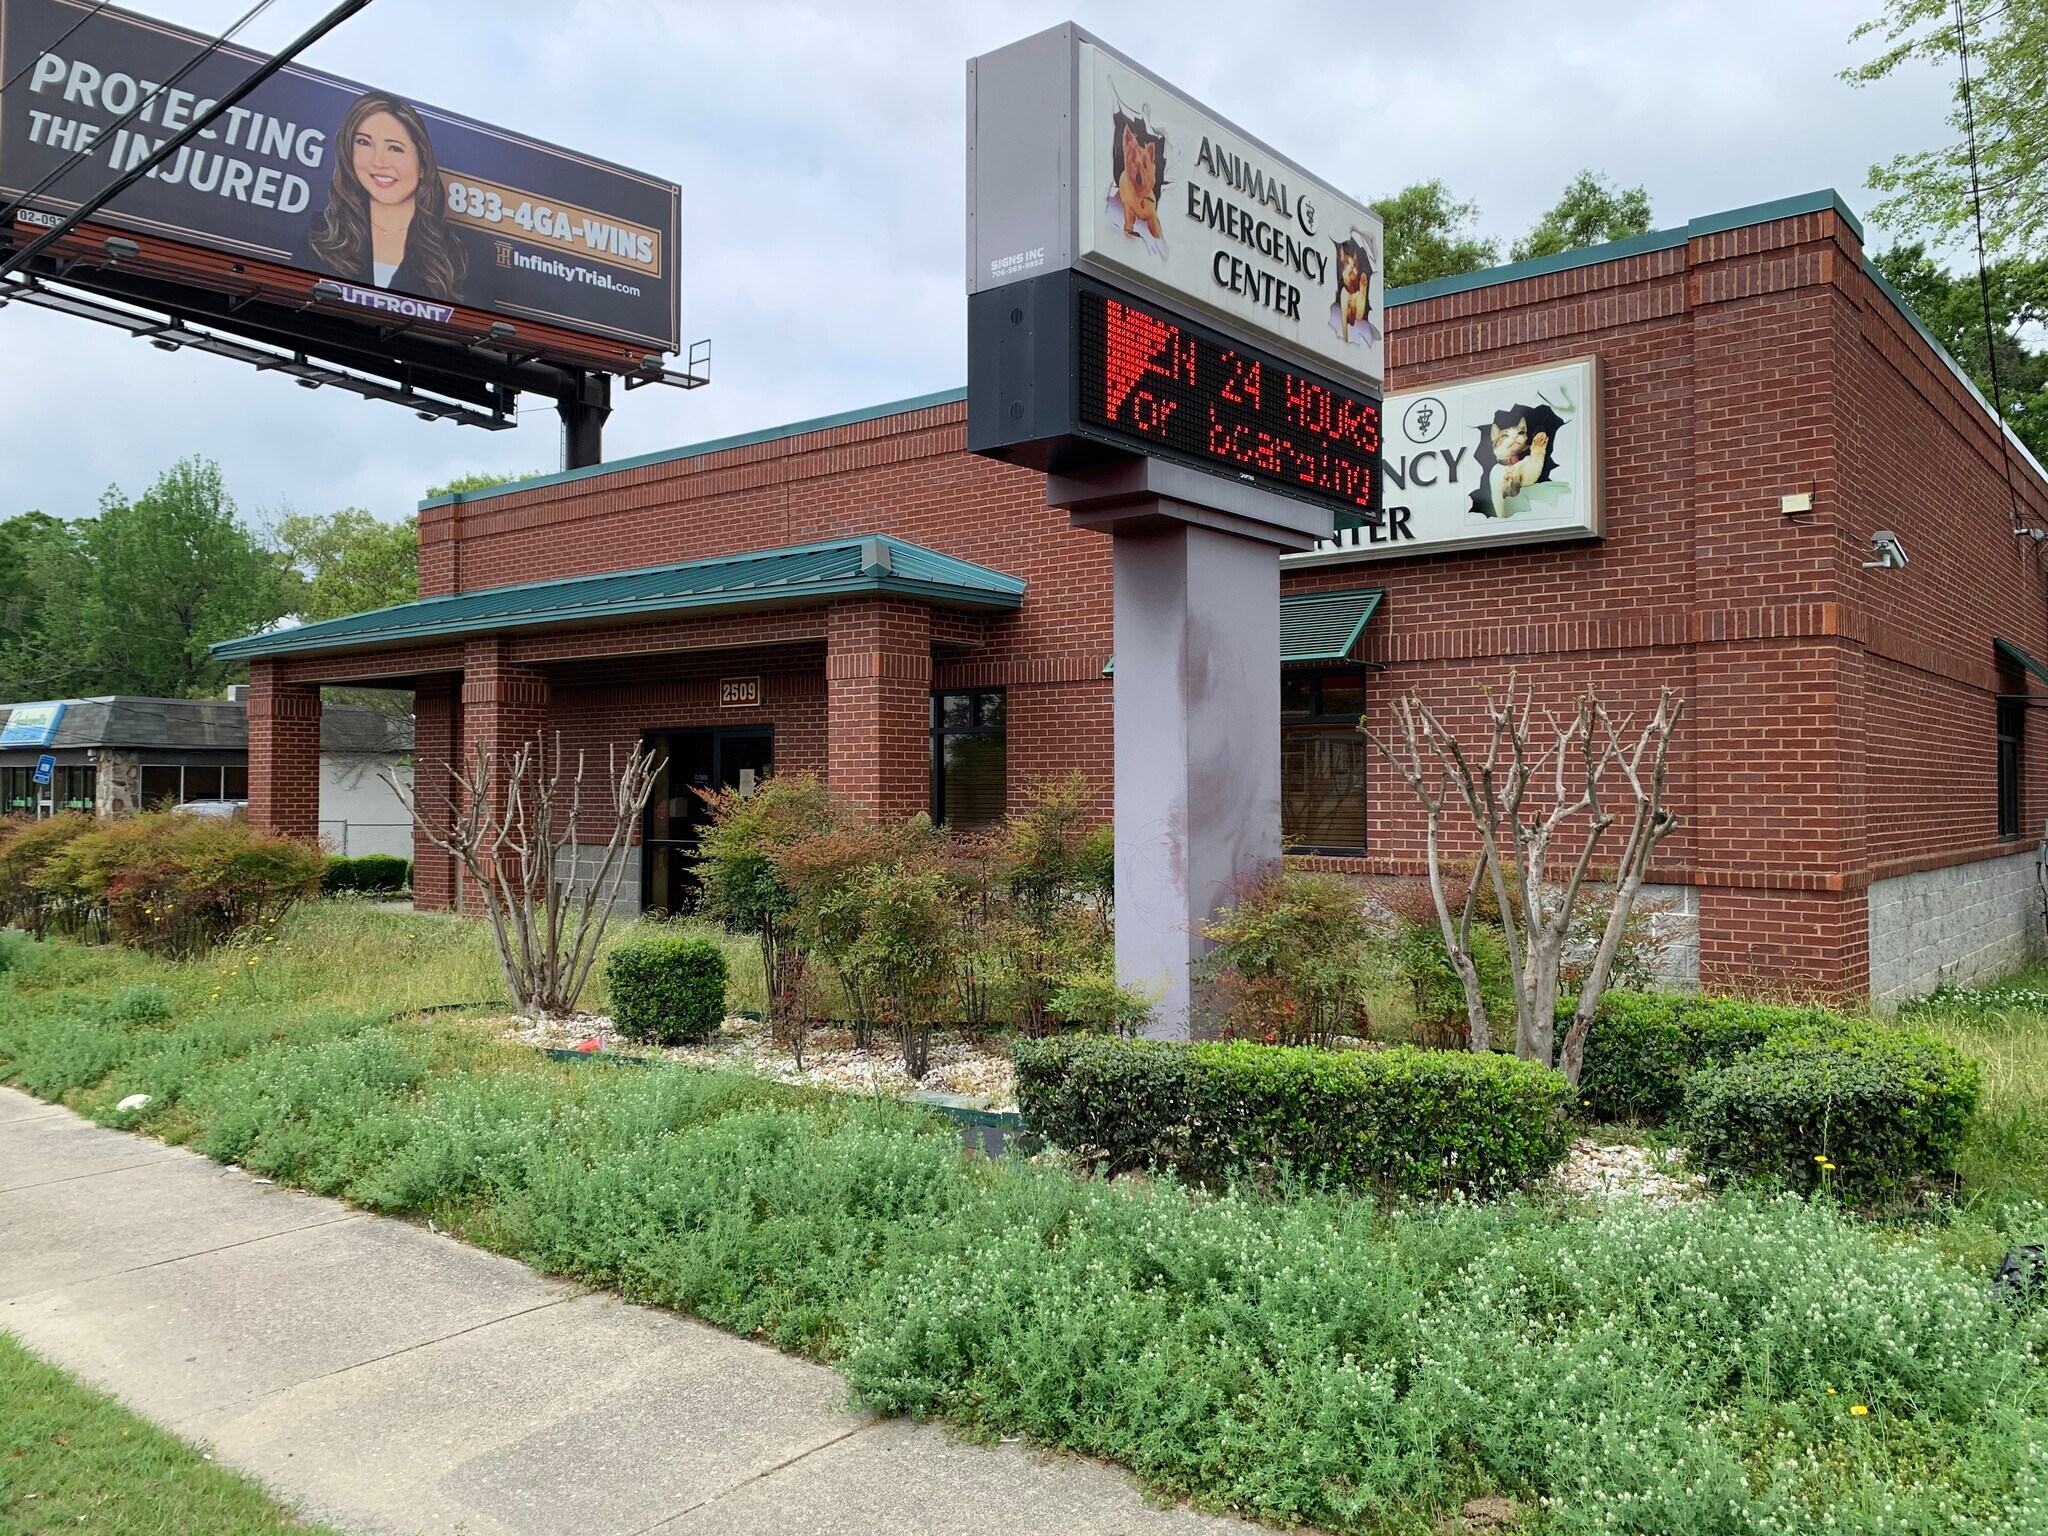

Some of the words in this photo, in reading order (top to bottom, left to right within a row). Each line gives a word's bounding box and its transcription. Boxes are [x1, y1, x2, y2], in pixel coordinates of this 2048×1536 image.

[29, 50, 326, 169] PROTECTING
[28, 109, 100, 156] THE
[108, 128, 311, 214] INJURED
[1194, 135, 1293, 219] ANIMAL
[447, 182, 653, 264] 833-4GA-WINS
[990, 252, 1024, 271] SIGNS
[1025, 246, 1045, 261] INC
[1186, 181, 1328, 285] EMERGENCY
[328, 283, 446, 322] UTFRONT
[513, 250, 641, 297] InfinityTrial.com
[991, 257, 1045, 279] 706-569-9952
[1213, 250, 1301, 322] CENTER
[1221, 350, 1262, 411] 24
[1286, 373, 1380, 454] HOURS
[722, 682, 756, 701] 2509
